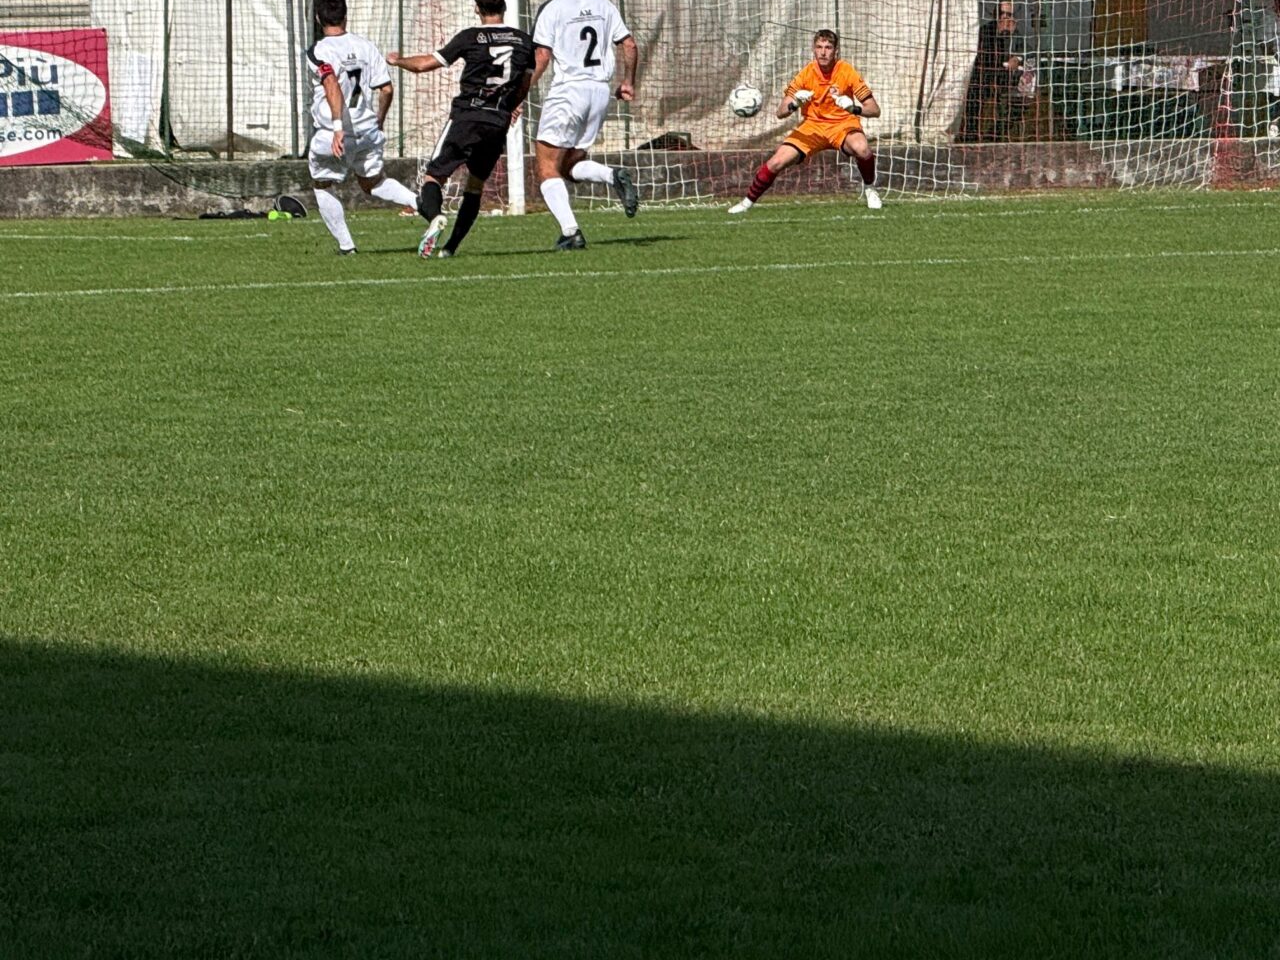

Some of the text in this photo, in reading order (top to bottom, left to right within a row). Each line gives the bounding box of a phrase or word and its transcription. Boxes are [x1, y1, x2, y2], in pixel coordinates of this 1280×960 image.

[486, 45, 514, 85] 3
[580, 25, 601, 68] 2
[346, 68, 362, 108] 7
